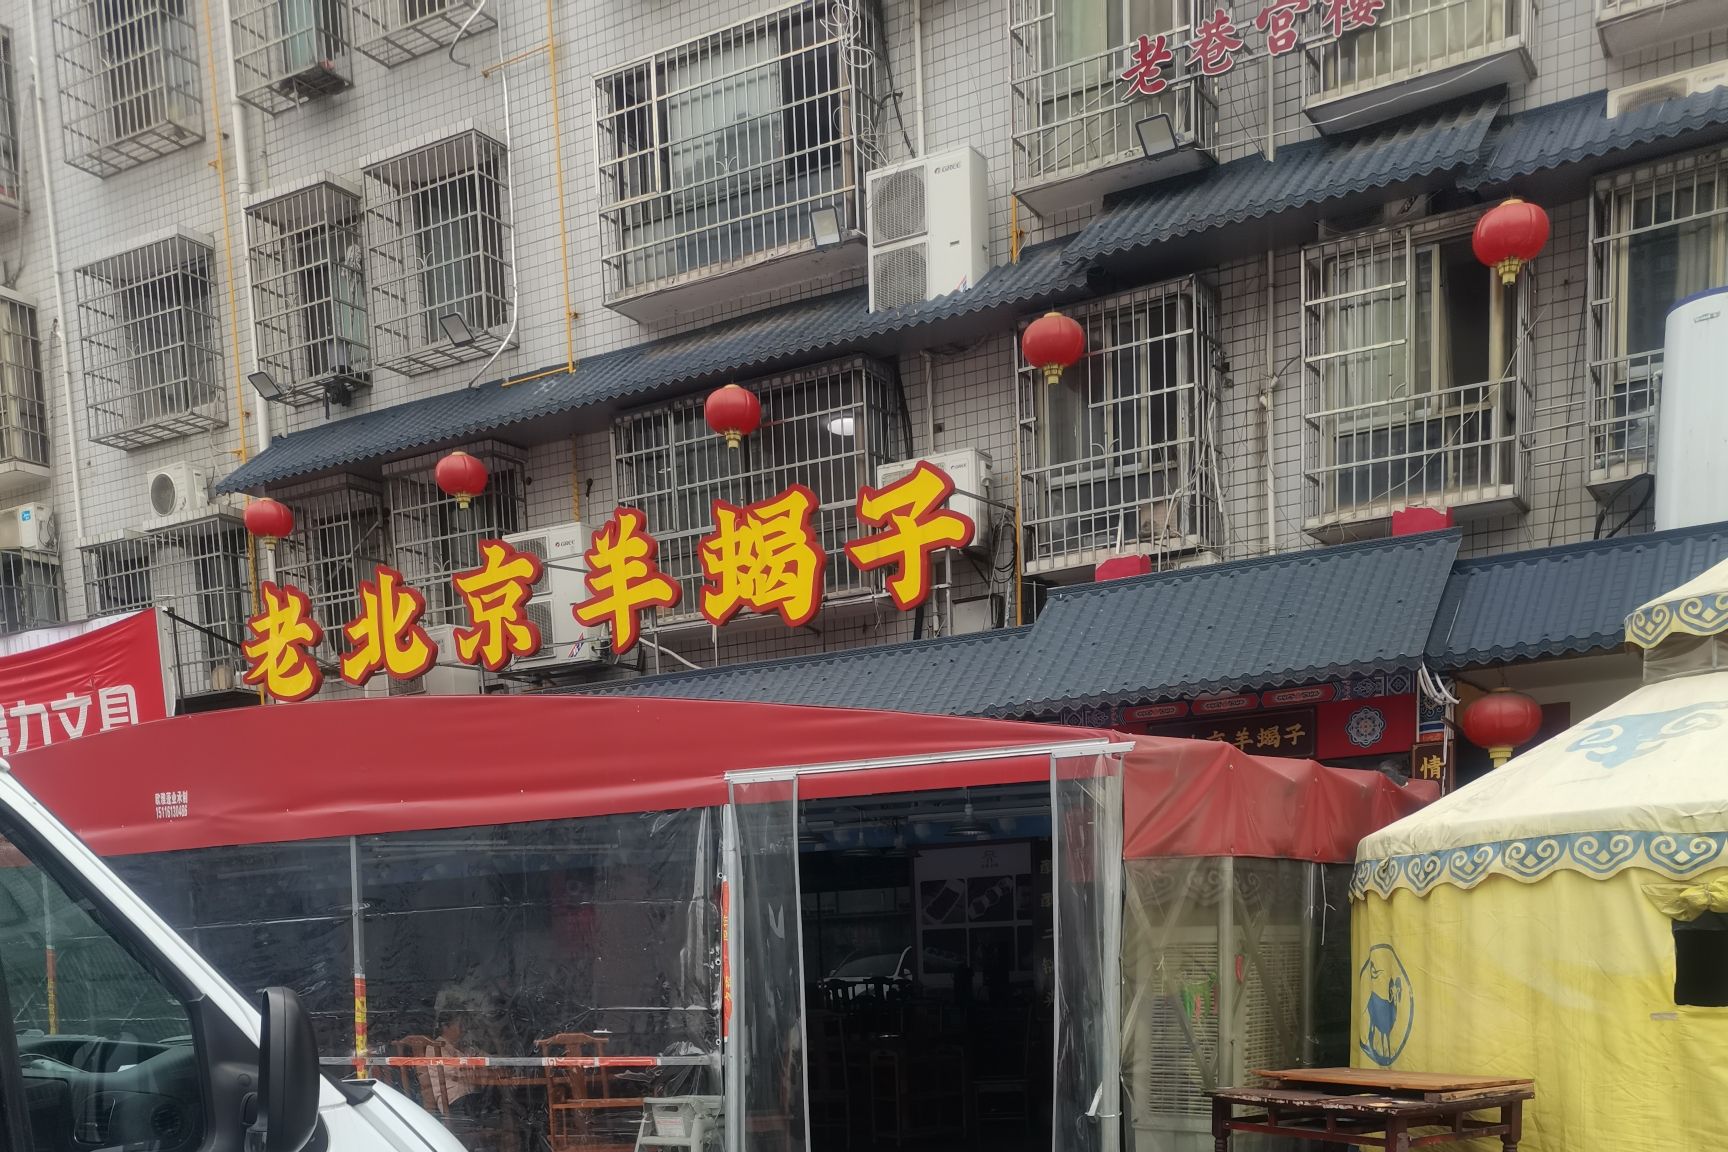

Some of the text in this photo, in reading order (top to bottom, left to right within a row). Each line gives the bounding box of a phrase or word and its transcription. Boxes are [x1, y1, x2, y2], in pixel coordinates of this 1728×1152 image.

[242, 460, 975, 701] 老北京羊蝎子
[0, 684, 139, 756] 力文具
[1191, 723, 1306, 750] 羊蝎子
[1420, 754, 1441, 780] 情
